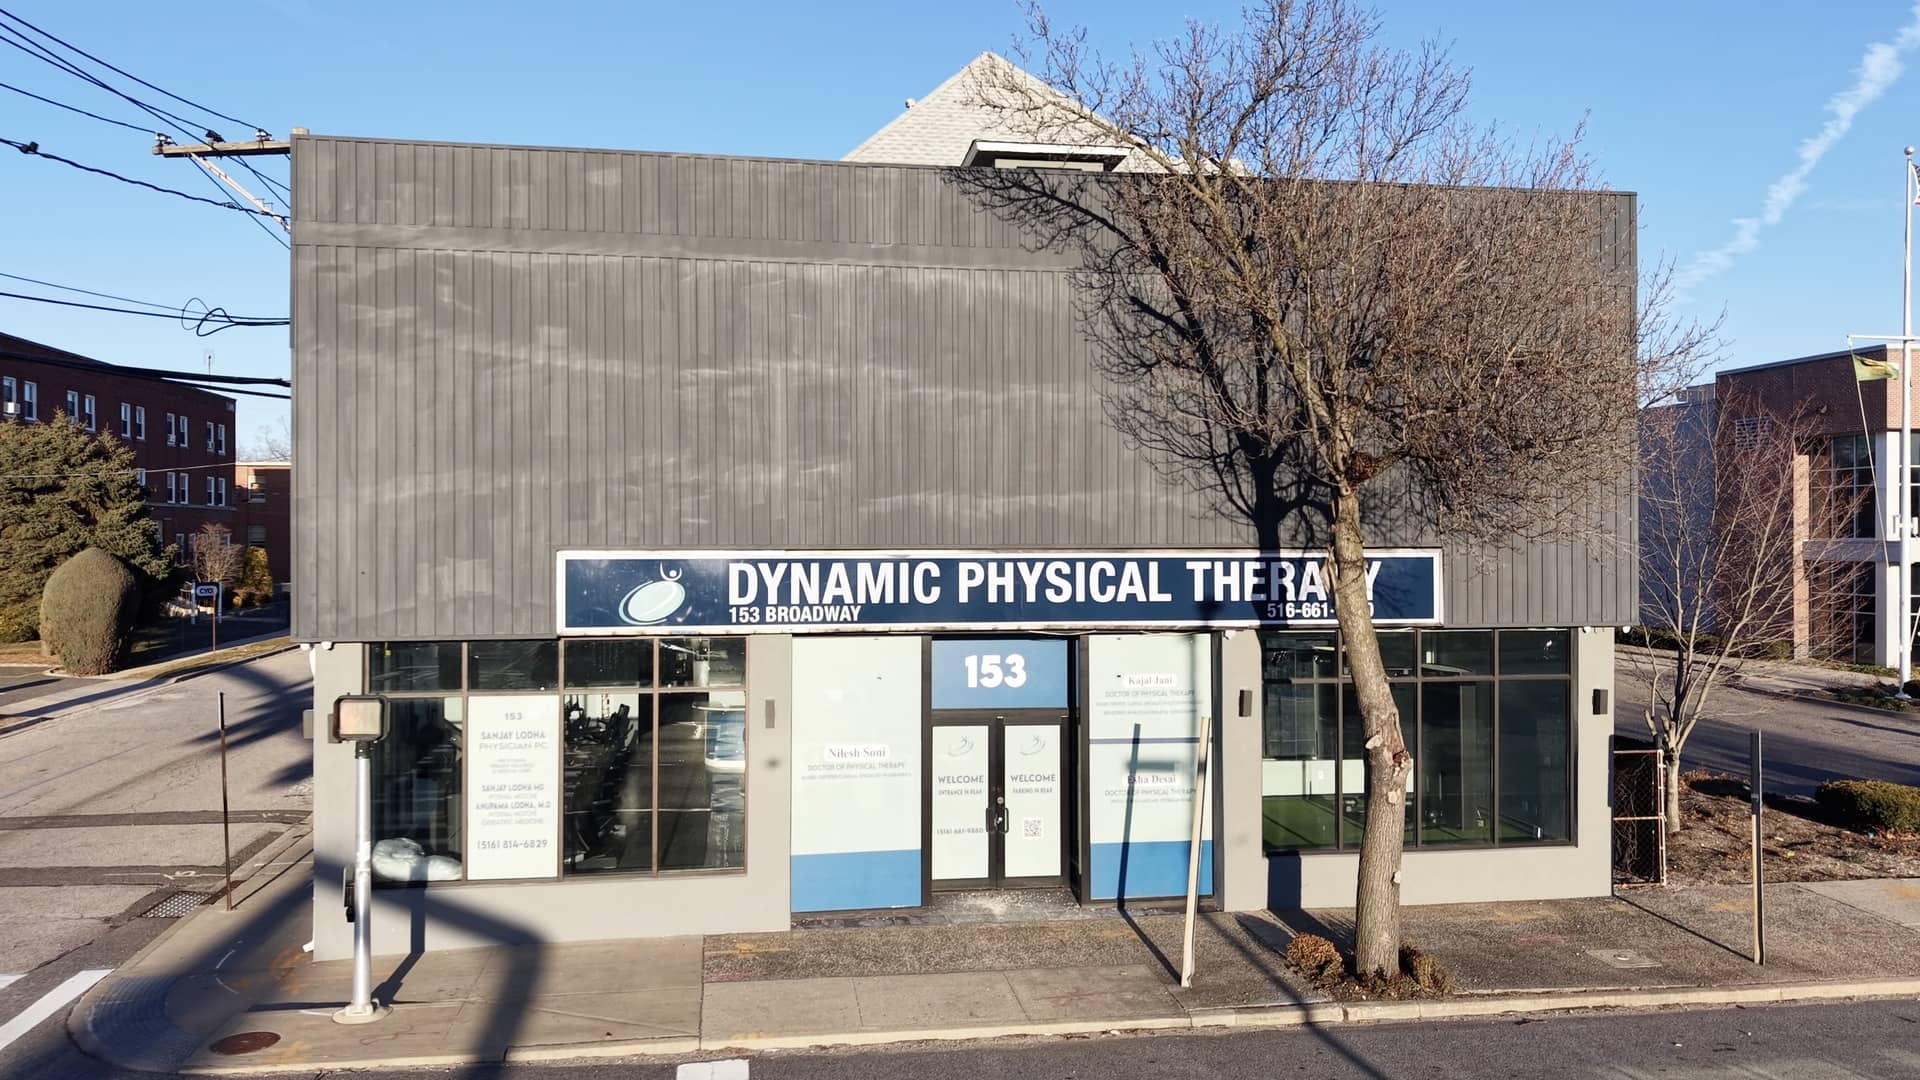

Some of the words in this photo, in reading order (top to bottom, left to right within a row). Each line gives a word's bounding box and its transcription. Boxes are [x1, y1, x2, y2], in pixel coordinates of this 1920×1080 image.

[728, 561, 941, 606] DYNAMIC
[958, 560, 1173, 604] PHYSICAL
[1186, 560, 1382, 602] THERAY
[728, 606, 760, 623] 153
[765, 605, 862, 623] BROADWAY
[964, 653, 1027, 688] 153
[504, 712, 523, 721] 153
[481, 730, 513, 740] SANJAY
[515, 730, 547, 740] LODHA
[829, 748, 861, 759] Nilesh
[863, 746, 886, 758] Soni
[937, 775, 985, 784] WELCOME
[1010, 774, 1057, 783] WELCOME
[503, 838, 549, 849] 814-6829
